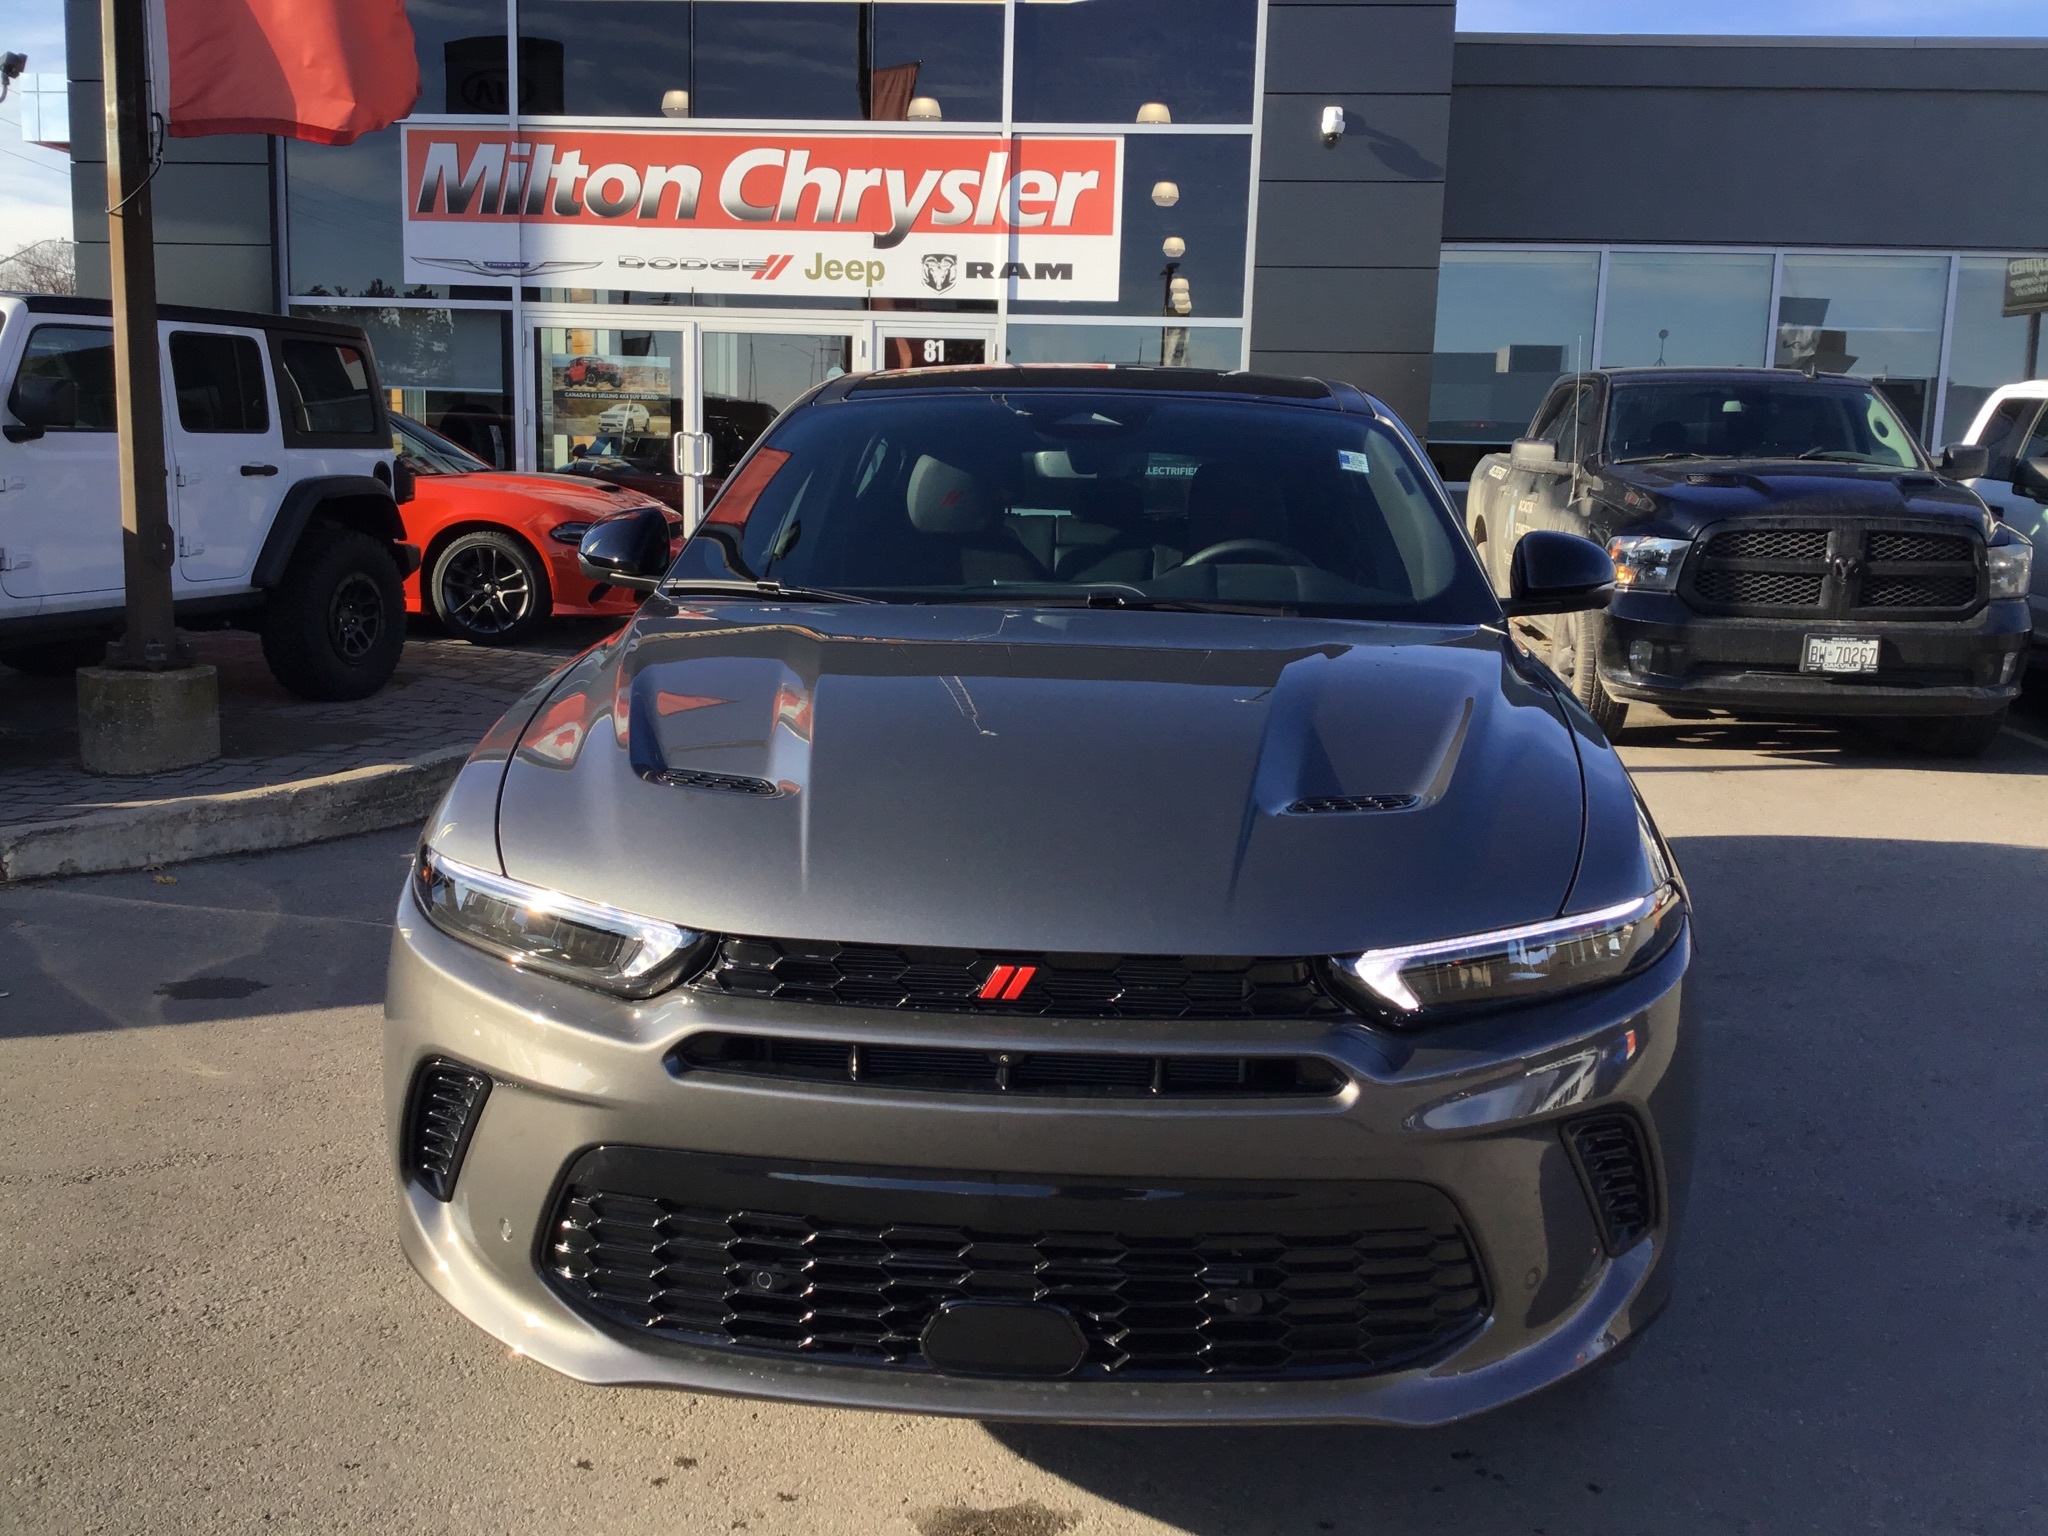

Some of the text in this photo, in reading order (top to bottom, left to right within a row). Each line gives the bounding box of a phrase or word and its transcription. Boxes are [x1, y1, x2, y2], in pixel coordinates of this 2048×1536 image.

[416, 141, 1100, 249] Milton Chrysler
[618, 255, 770, 272] DODGE
[805, 253, 885, 287] Jeep
[966, 261, 1074, 280] RAM
[923, 339, 945, 362] 81
[598, 392, 619, 400] SELLING
